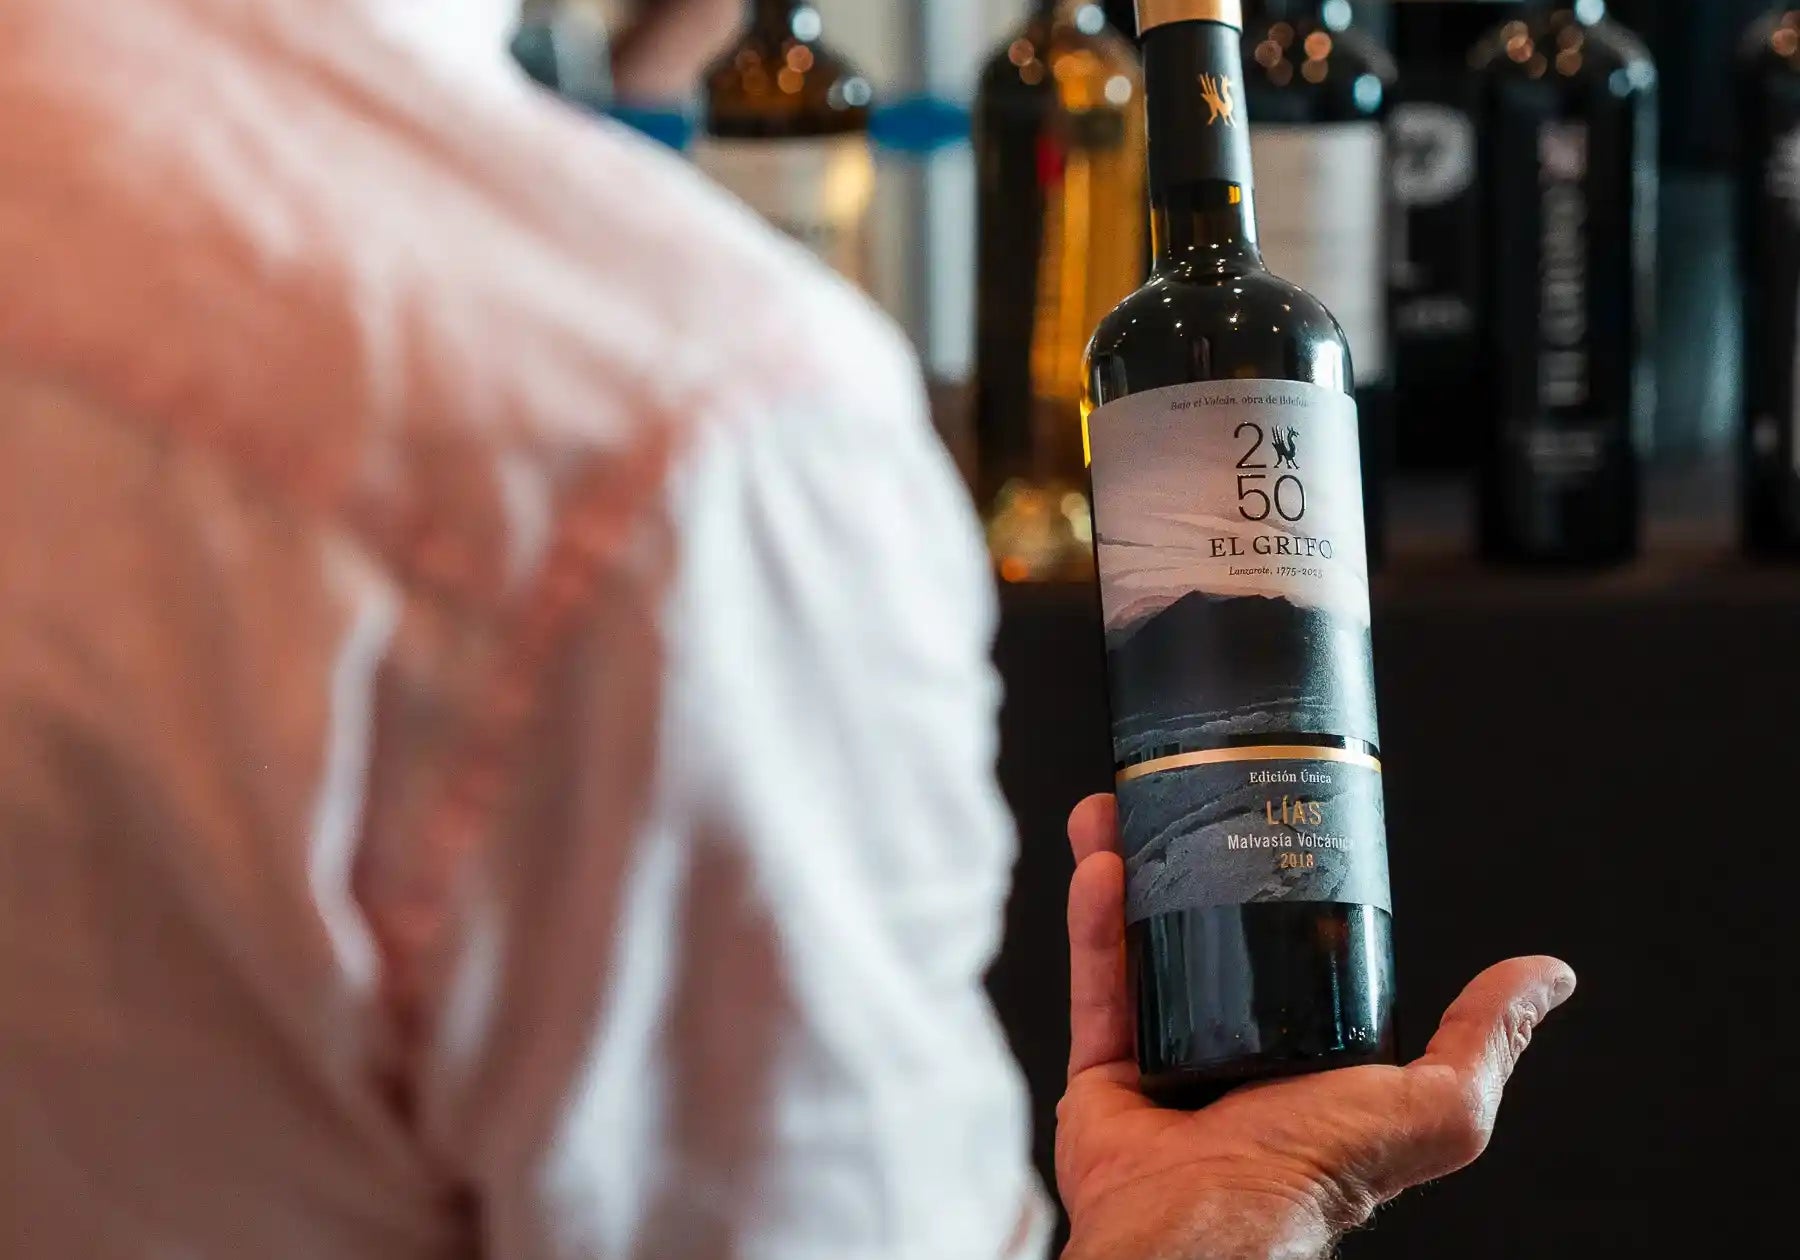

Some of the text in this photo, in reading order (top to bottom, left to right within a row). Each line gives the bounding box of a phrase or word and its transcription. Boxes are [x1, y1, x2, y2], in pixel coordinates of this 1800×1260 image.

[1241, 395, 1263, 405] obra
[1265, 395, 1278, 405] de
[1233, 421, 1267, 469] 2
[1236, 473, 1306, 522] 50
[1208, 535, 1333, 560] EL GRIFO
[1229, 566, 1273, 577] Lanzarote,
[1250, 769, 1332, 785] Edición Única
[1265, 794, 1323, 826] LÍAS
[1227, 832, 1293, 850] Malvasía
[1280, 853, 1314, 869] 2018
